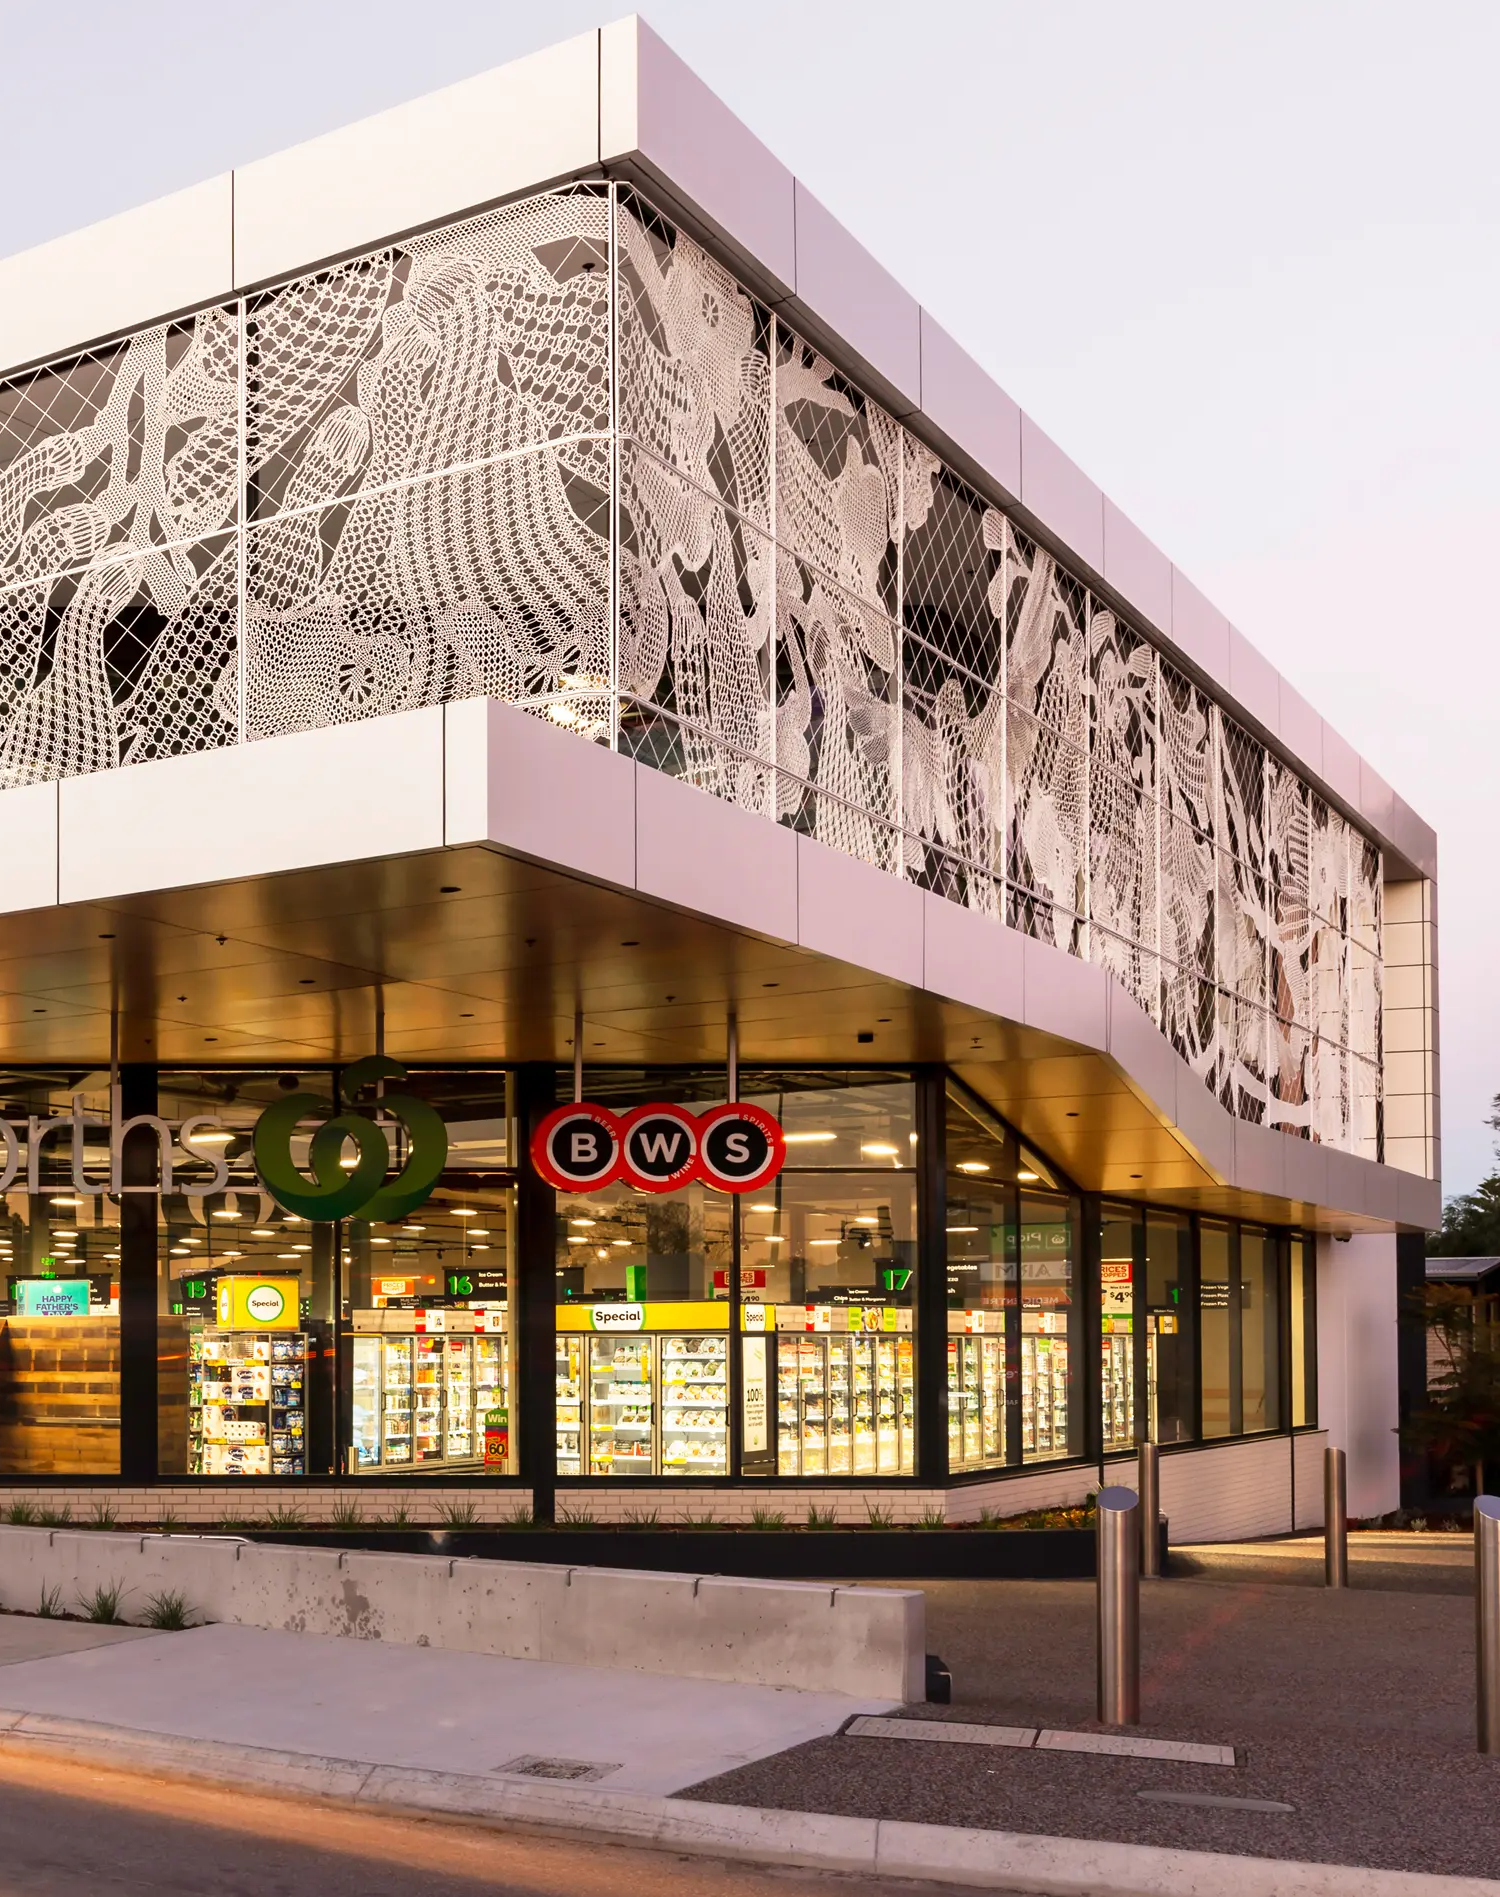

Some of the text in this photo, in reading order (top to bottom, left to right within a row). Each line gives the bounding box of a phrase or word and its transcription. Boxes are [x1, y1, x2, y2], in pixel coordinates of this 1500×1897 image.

[594, 1117, 617, 1138] BEER
[742, 1114, 774, 1144] SPIRITS
[671, 1157, 695, 1180] WINE
[946, 1264, 978, 1272] egetables
[1100, 1265, 1127, 1273] RICES
[448, 1275, 473, 1295] 16
[882, 1269, 913, 1291] 17
[186, 1280, 206, 1299] 15
[41, 1295, 73, 1303] HAPPY
[833, 1295, 848, 1304] Chips
[36, 1303, 79, 1311] FATHER'S
[172, 1303, 183, 1315] 11
[595, 1310, 641, 1324] Special
[746, 1311, 765, 1324] Special
[487, 1413, 508, 1423] Win
[488, 1443, 505, 1455] 60
